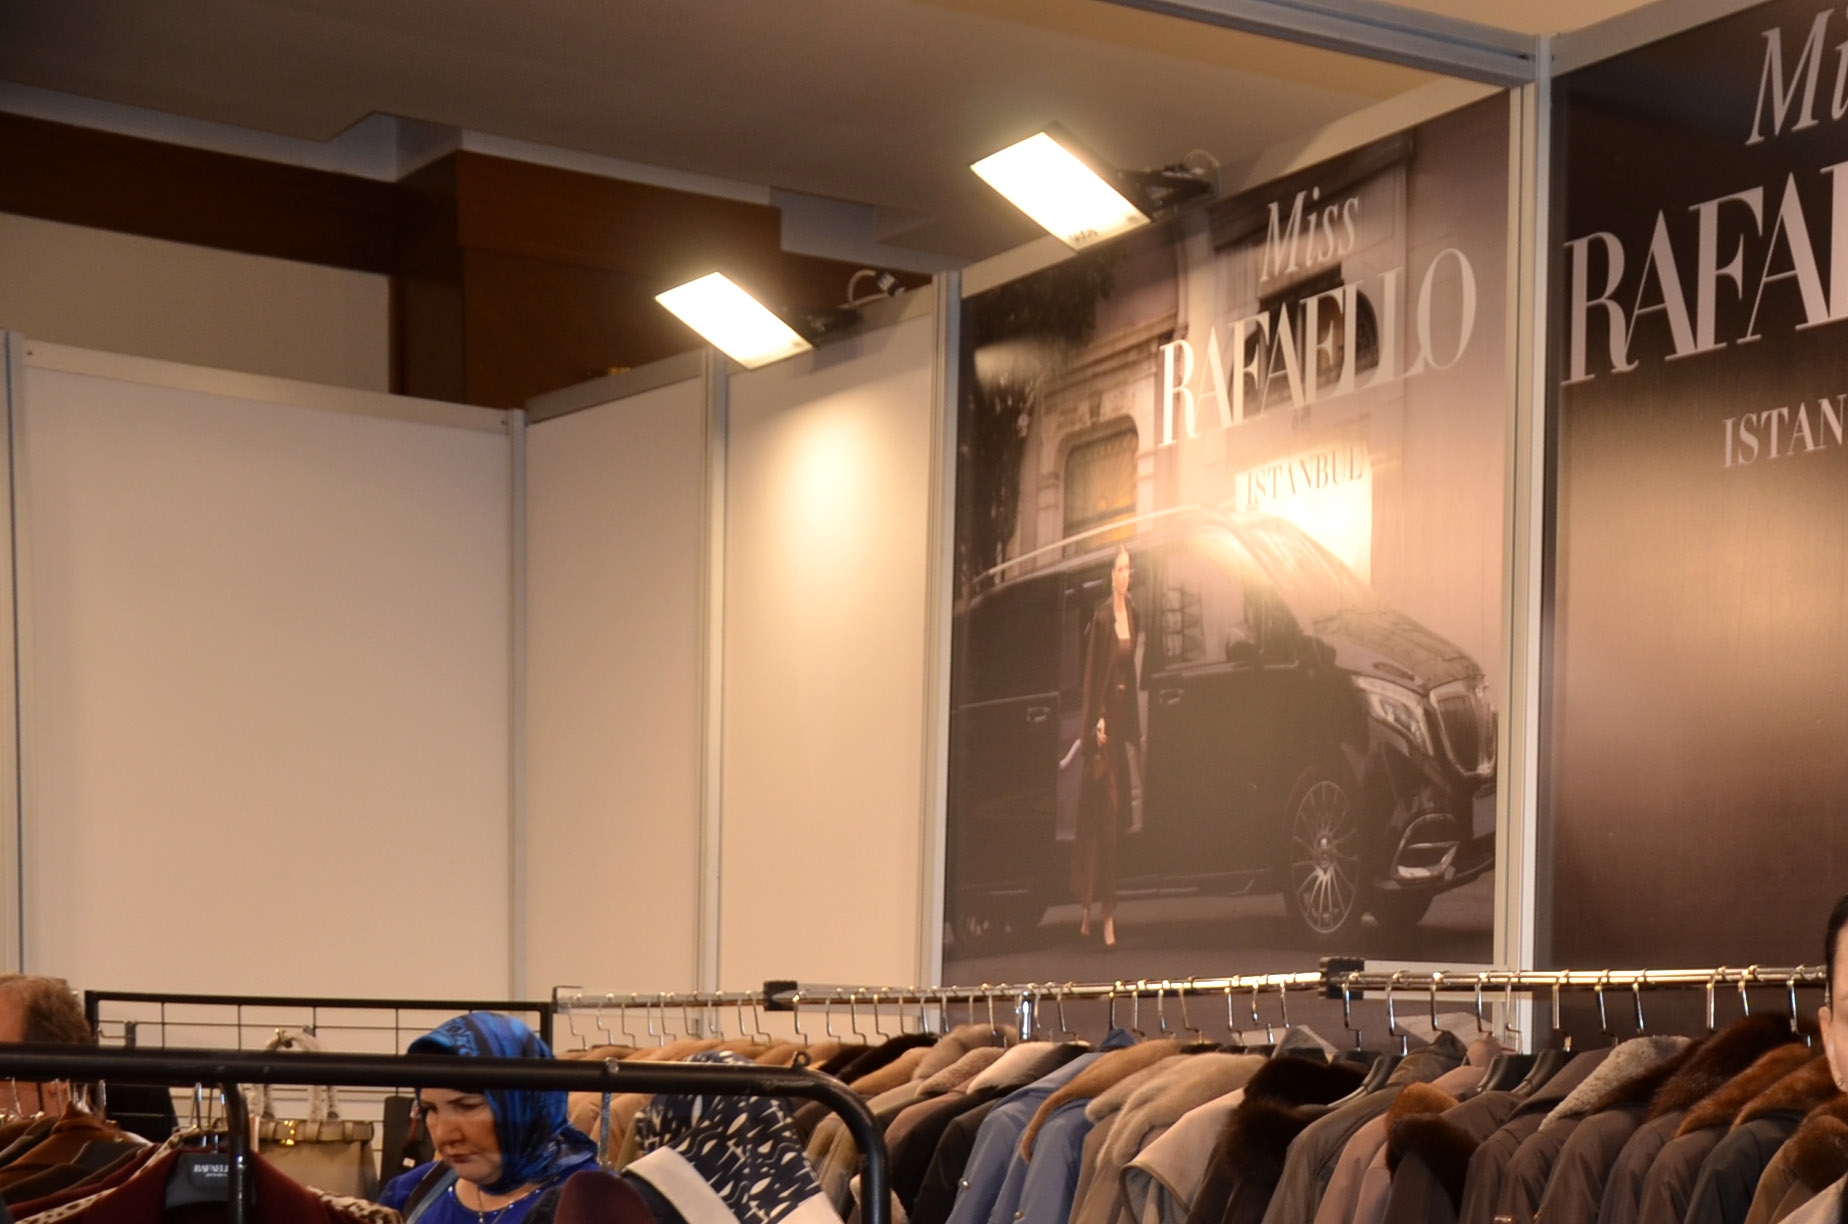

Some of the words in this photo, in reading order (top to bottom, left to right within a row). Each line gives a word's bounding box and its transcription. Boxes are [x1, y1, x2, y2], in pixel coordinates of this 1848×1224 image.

[1260, 186, 1360, 283] Miss
[1157, 247, 1477, 448] RAFAELLO
[1246, 446, 1367, 508] ISTANBUL
